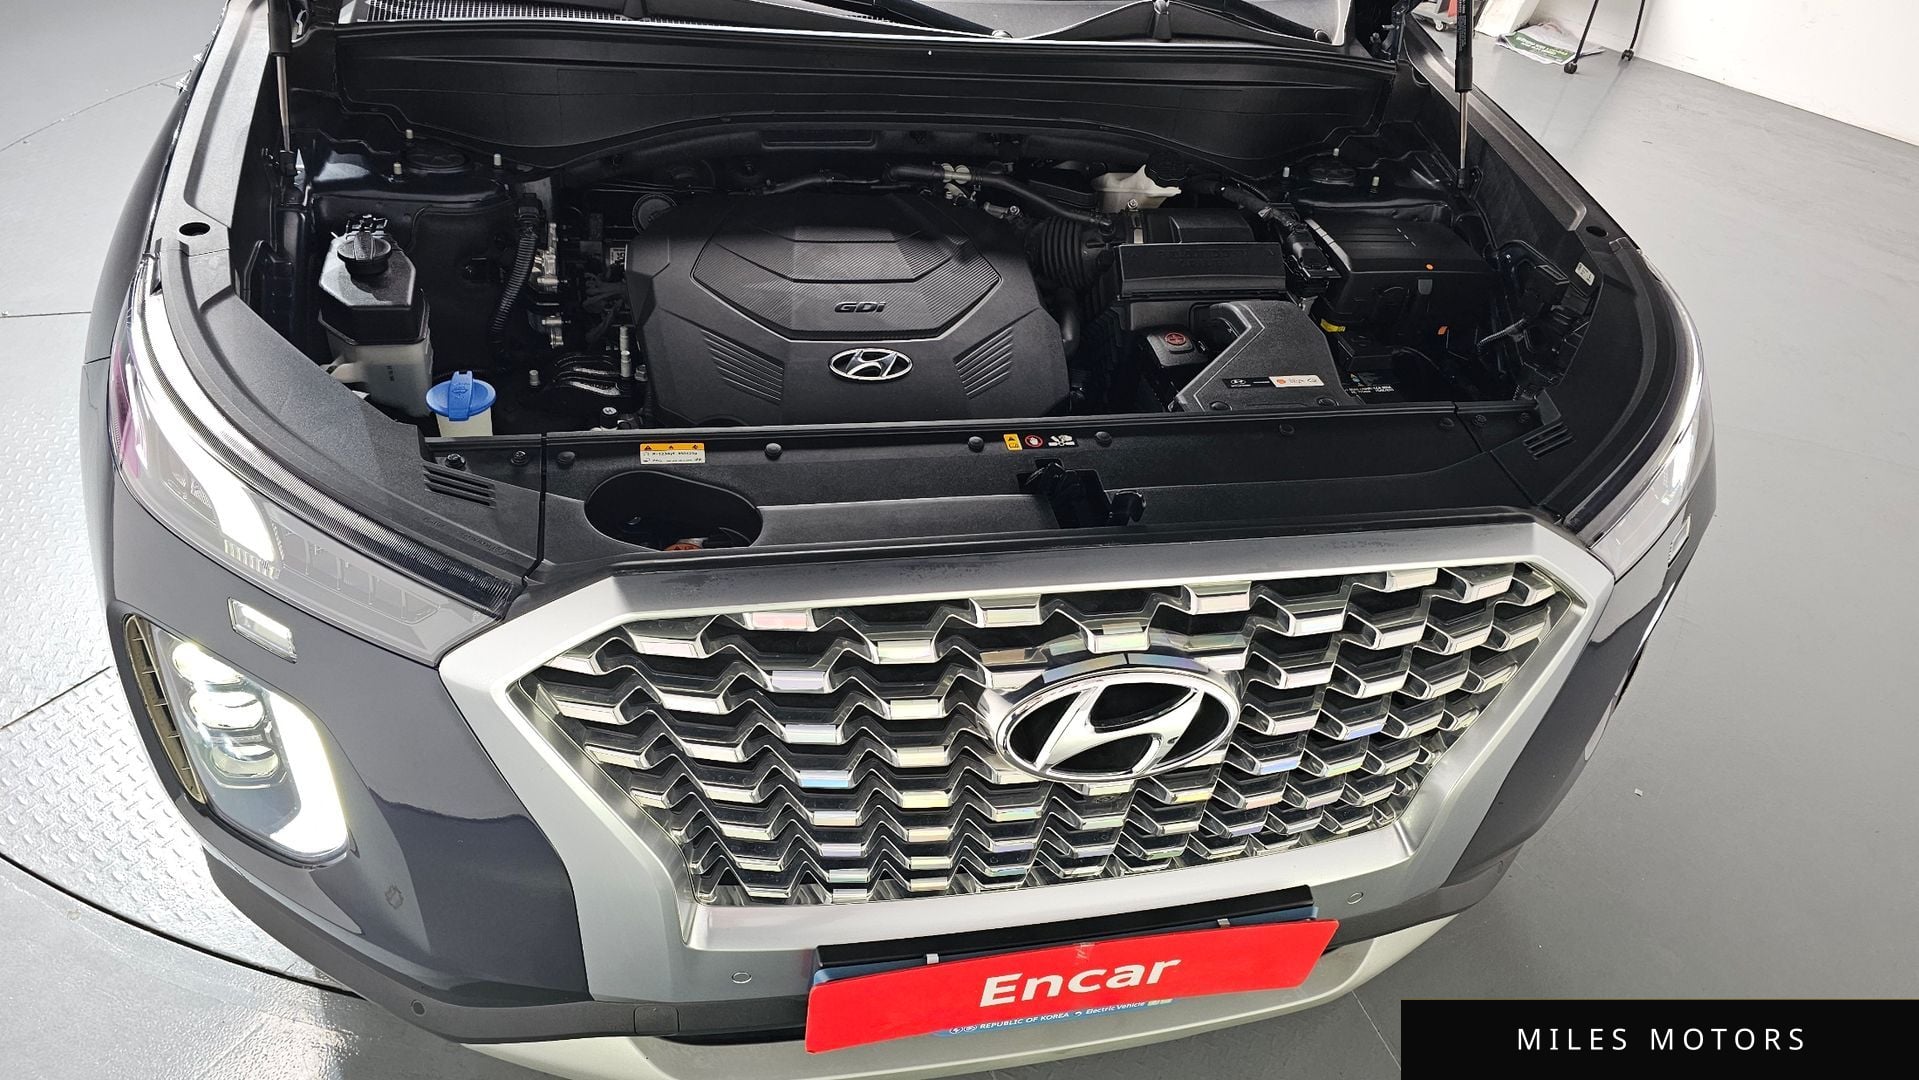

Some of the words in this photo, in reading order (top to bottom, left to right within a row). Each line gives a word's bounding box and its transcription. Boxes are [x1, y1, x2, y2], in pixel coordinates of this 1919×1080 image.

[834, 301, 886, 313] GDi
[979, 959, 1182, 1008] Encar
[980, 1018, 1023, 1029] REPUBLIC
[1025, 1016, 1038, 1024] OF
[1040, 1012, 1069, 1022] KOREA
[1085, 1006, 1116, 1015] Electric
[1116, 1001, 1146, 1010] Vehicle
